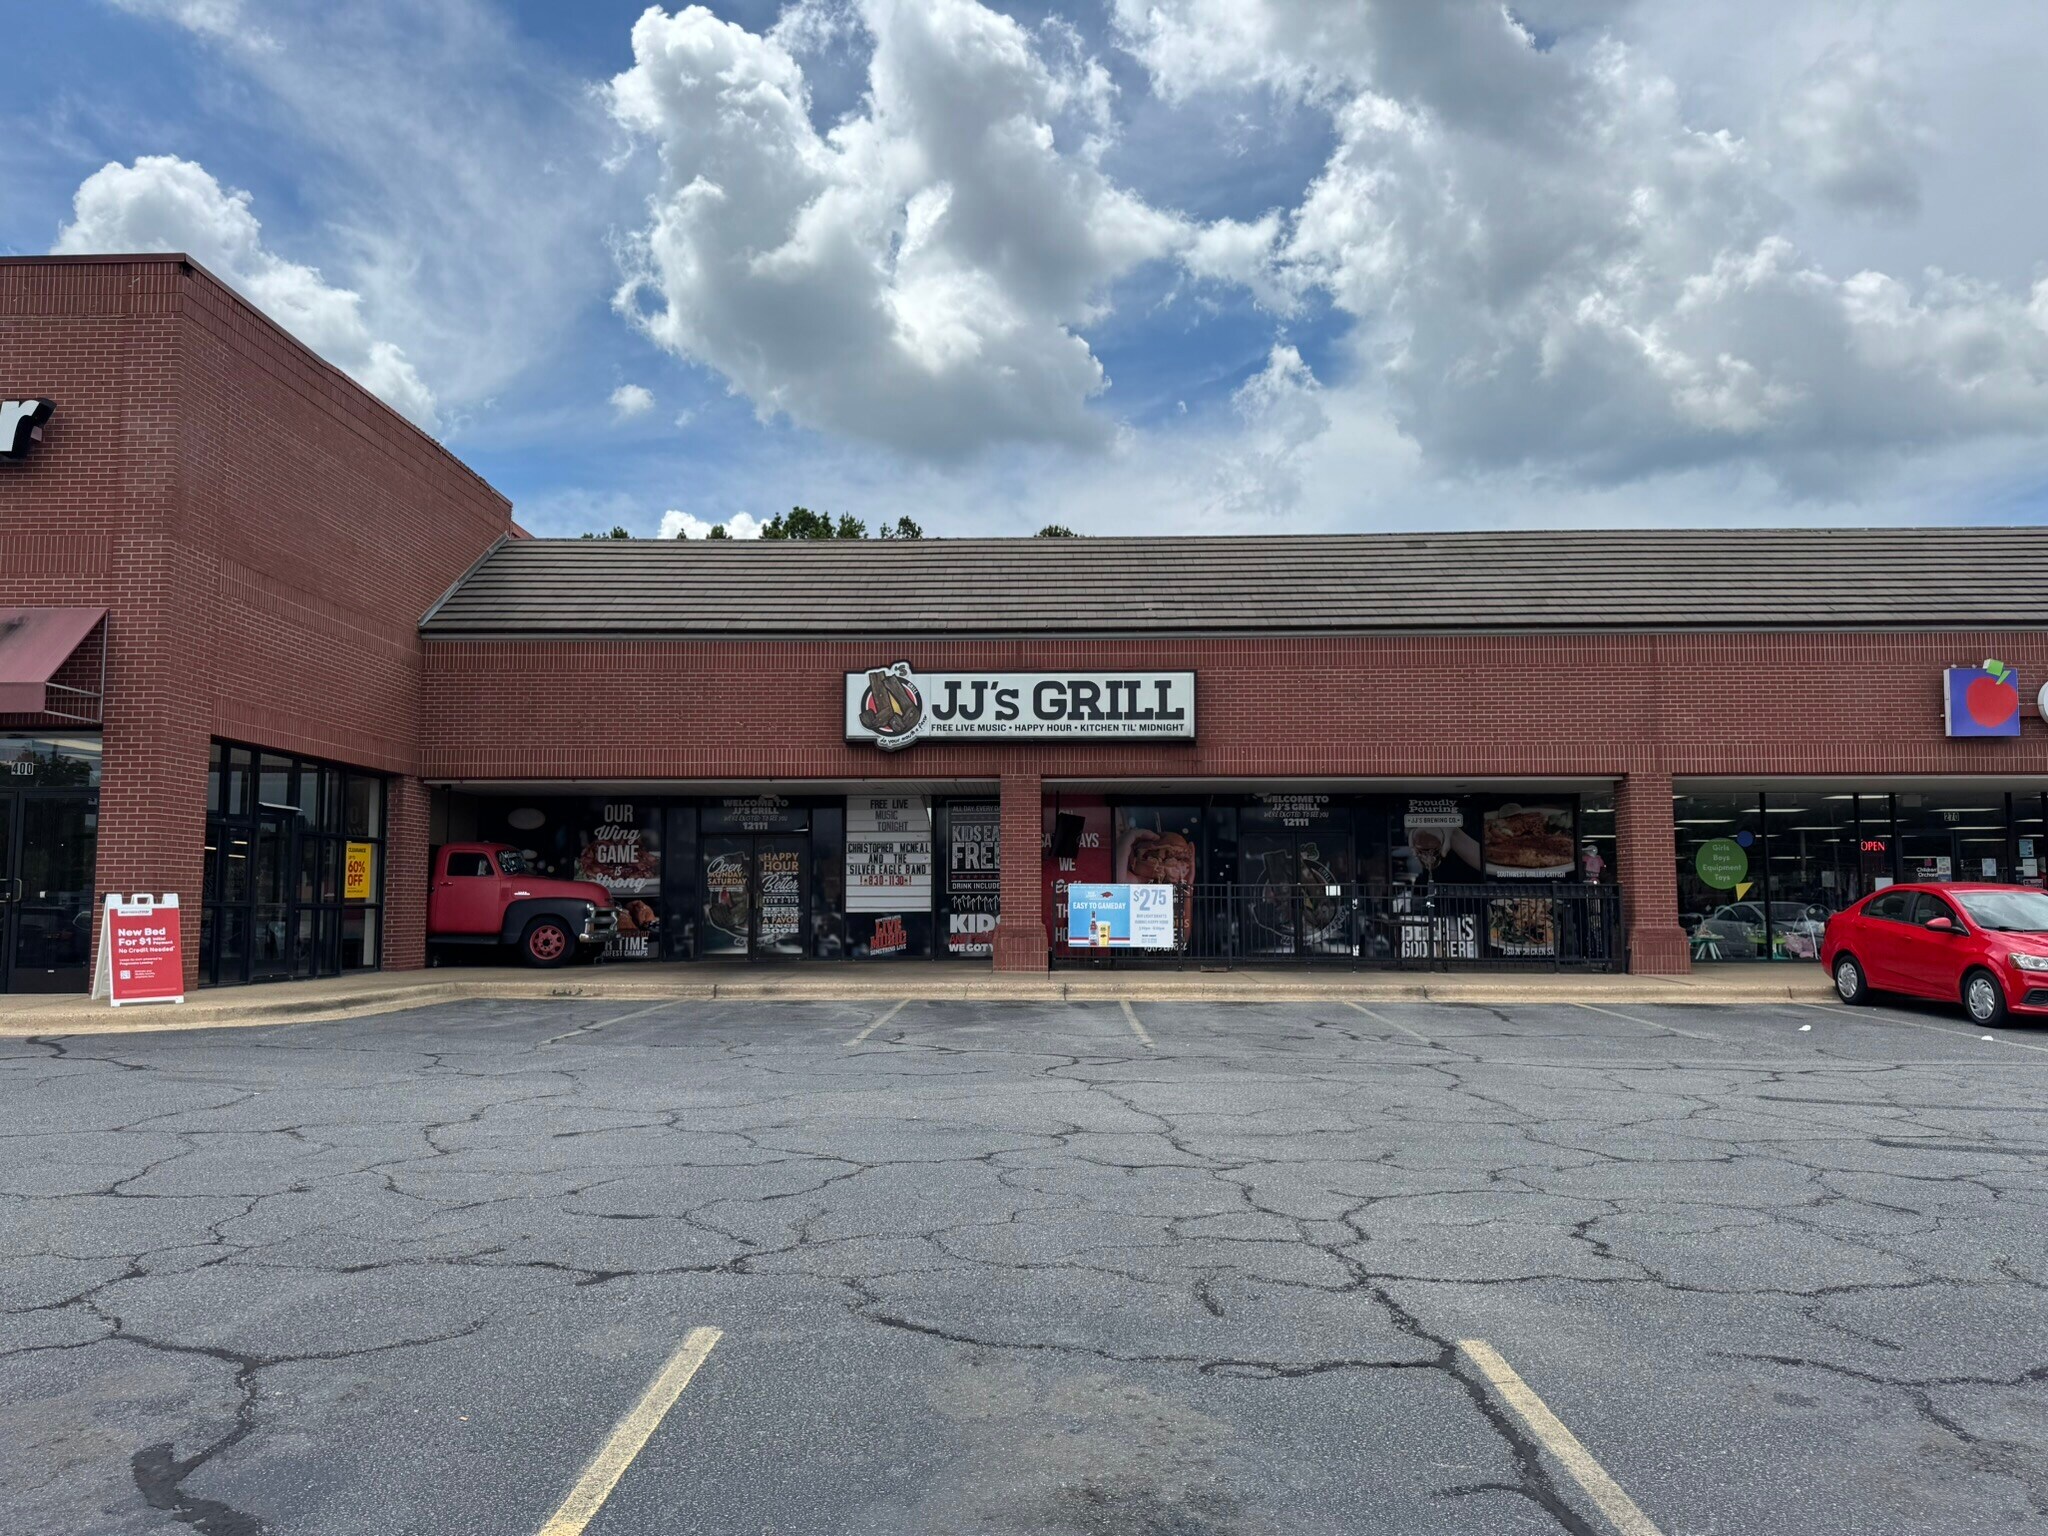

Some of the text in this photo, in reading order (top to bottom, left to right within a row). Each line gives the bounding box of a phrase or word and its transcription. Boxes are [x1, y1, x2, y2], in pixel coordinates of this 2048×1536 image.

[932, 680, 1184, 720] JJ's GRILL
[931, 724, 953, 732] FREE
[955, 724, 975, 732] LIVE
[977, 724, 1006, 732] MUSIC
[1014, 724, 1044, 732] HAPPY
[1046, 724, 1072, 732] HOUR
[1080, 724, 1119, 732] KITCHEN
[1138, 724, 1184, 732] MIDNIGHT
[12, 762, 33, 775] 400
[722, 799, 789, 807] WELCOME TO
[870, 799, 909, 809] FREE LIVE
[1262, 795, 1330, 803] WELCOME TO
[1408, 799, 1458, 807] Proudly
[604, 804, 634, 823] OUR
[875, 810, 898, 820] MUSIC
[1944, 813, 1959, 821] 270
[742, 821, 768, 830] 12111
[877, 821, 909, 831] TONIGHT
[1283, 818, 1309, 826] 12111
[594, 825, 640, 845] Wing
[952, 825, 1000, 841] KIDS EA
[848, 843, 929, 853] CHRISTOPHER MCNEAL
[1860, 841, 1885, 851] OPEN
[597, 845, 639, 863] GAME
[763, 852, 799, 861] HAPPY
[868, 854, 907, 864] AND THE
[1712, 854, 1730, 862] Boys
[348, 861, 366, 873] 60%
[706, 856, 744, 874] Open
[763, 861, 799, 871] HOUR
[1058, 856, 1076, 871] WE
[1702, 864, 1742, 872] Equipment
[849, 864, 926, 875] SILVER EAGLE BAND
[347, 874, 363, 886] OFF
[1714, 873, 1730, 882] Toys
[595, 873, 647, 893] Strong
[761, 874, 799, 892] Better
[952, 882, 1000, 890] DRINK INCLUDE
[1055, 903, 1068, 918] TH
[1072, 902, 1126, 910] EASY TO GAMEDAY
[950, 913, 1000, 933] KID
[118, 927, 166, 936] New Bed
[1055, 927, 1068, 942] HO
[118, 938, 137, 946] For
[139, 937, 152, 945] $1
[618, 937, 649, 950] TIME
[948, 943, 965, 952] WE
[966, 943, 989, 952] GOT
[624, 949, 649, 957] CHAMPS
